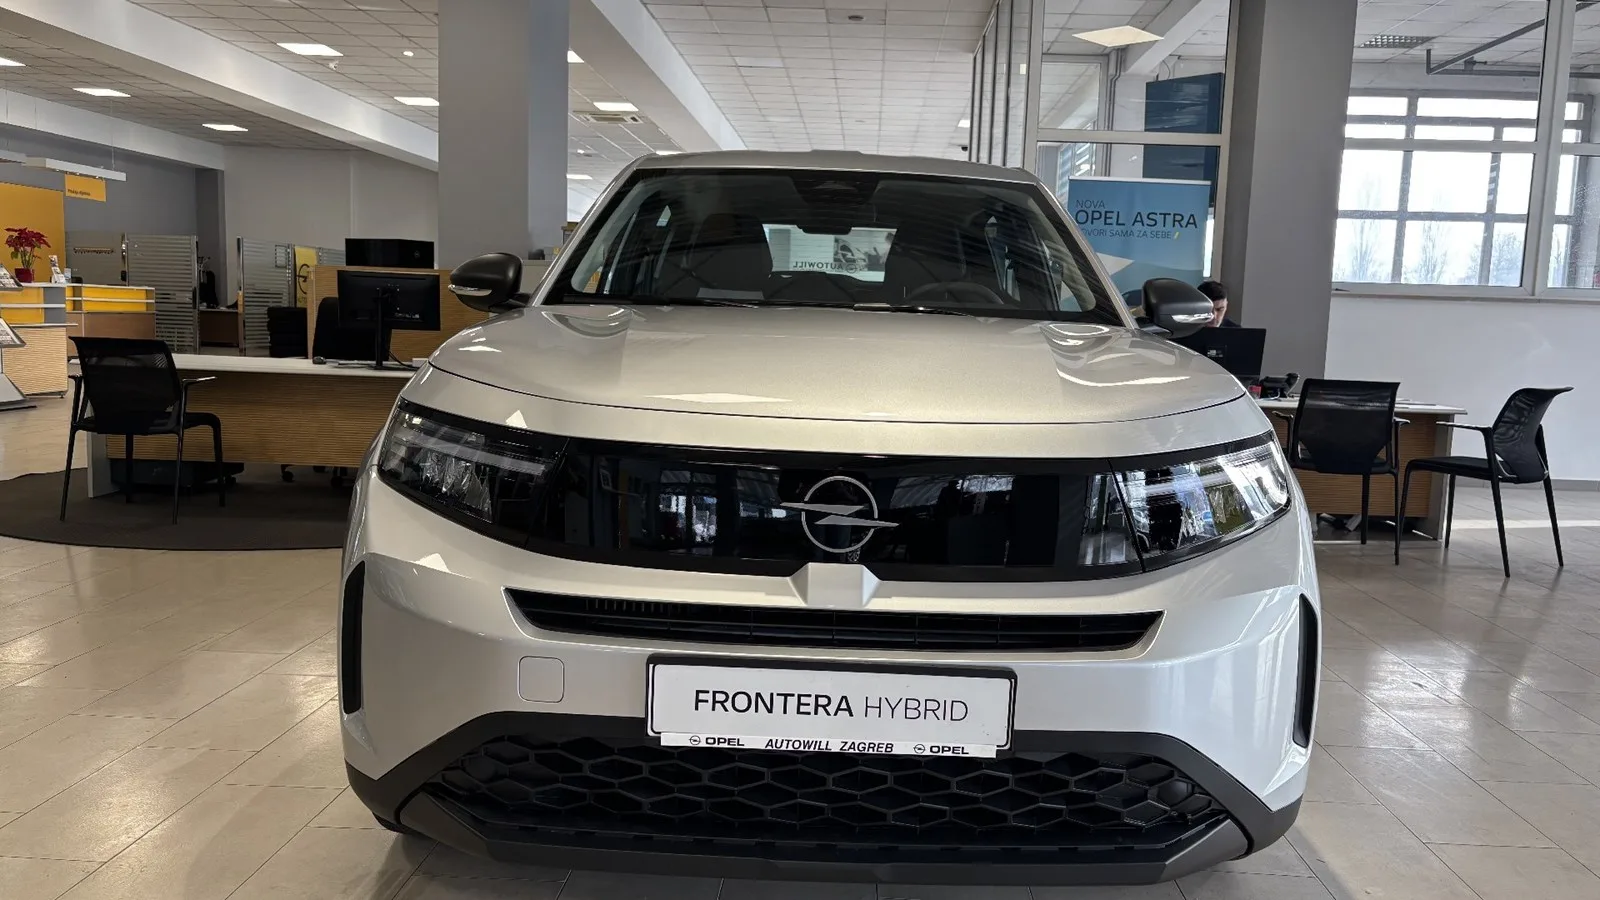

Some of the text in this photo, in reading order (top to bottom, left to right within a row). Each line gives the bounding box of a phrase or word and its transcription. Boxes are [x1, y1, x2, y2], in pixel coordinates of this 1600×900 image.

[1075, 199, 1106, 209] NOVA
[1075, 209, 1198, 229] OPEL ASTRA
[1081, 228, 1172, 239] OVORI SAMA ZA SEBE
[694, 689, 968, 722] FRONTERA HYBRID
[705, 737, 970, 755] OPEL AUTOWILL ZAGREB OPEL
